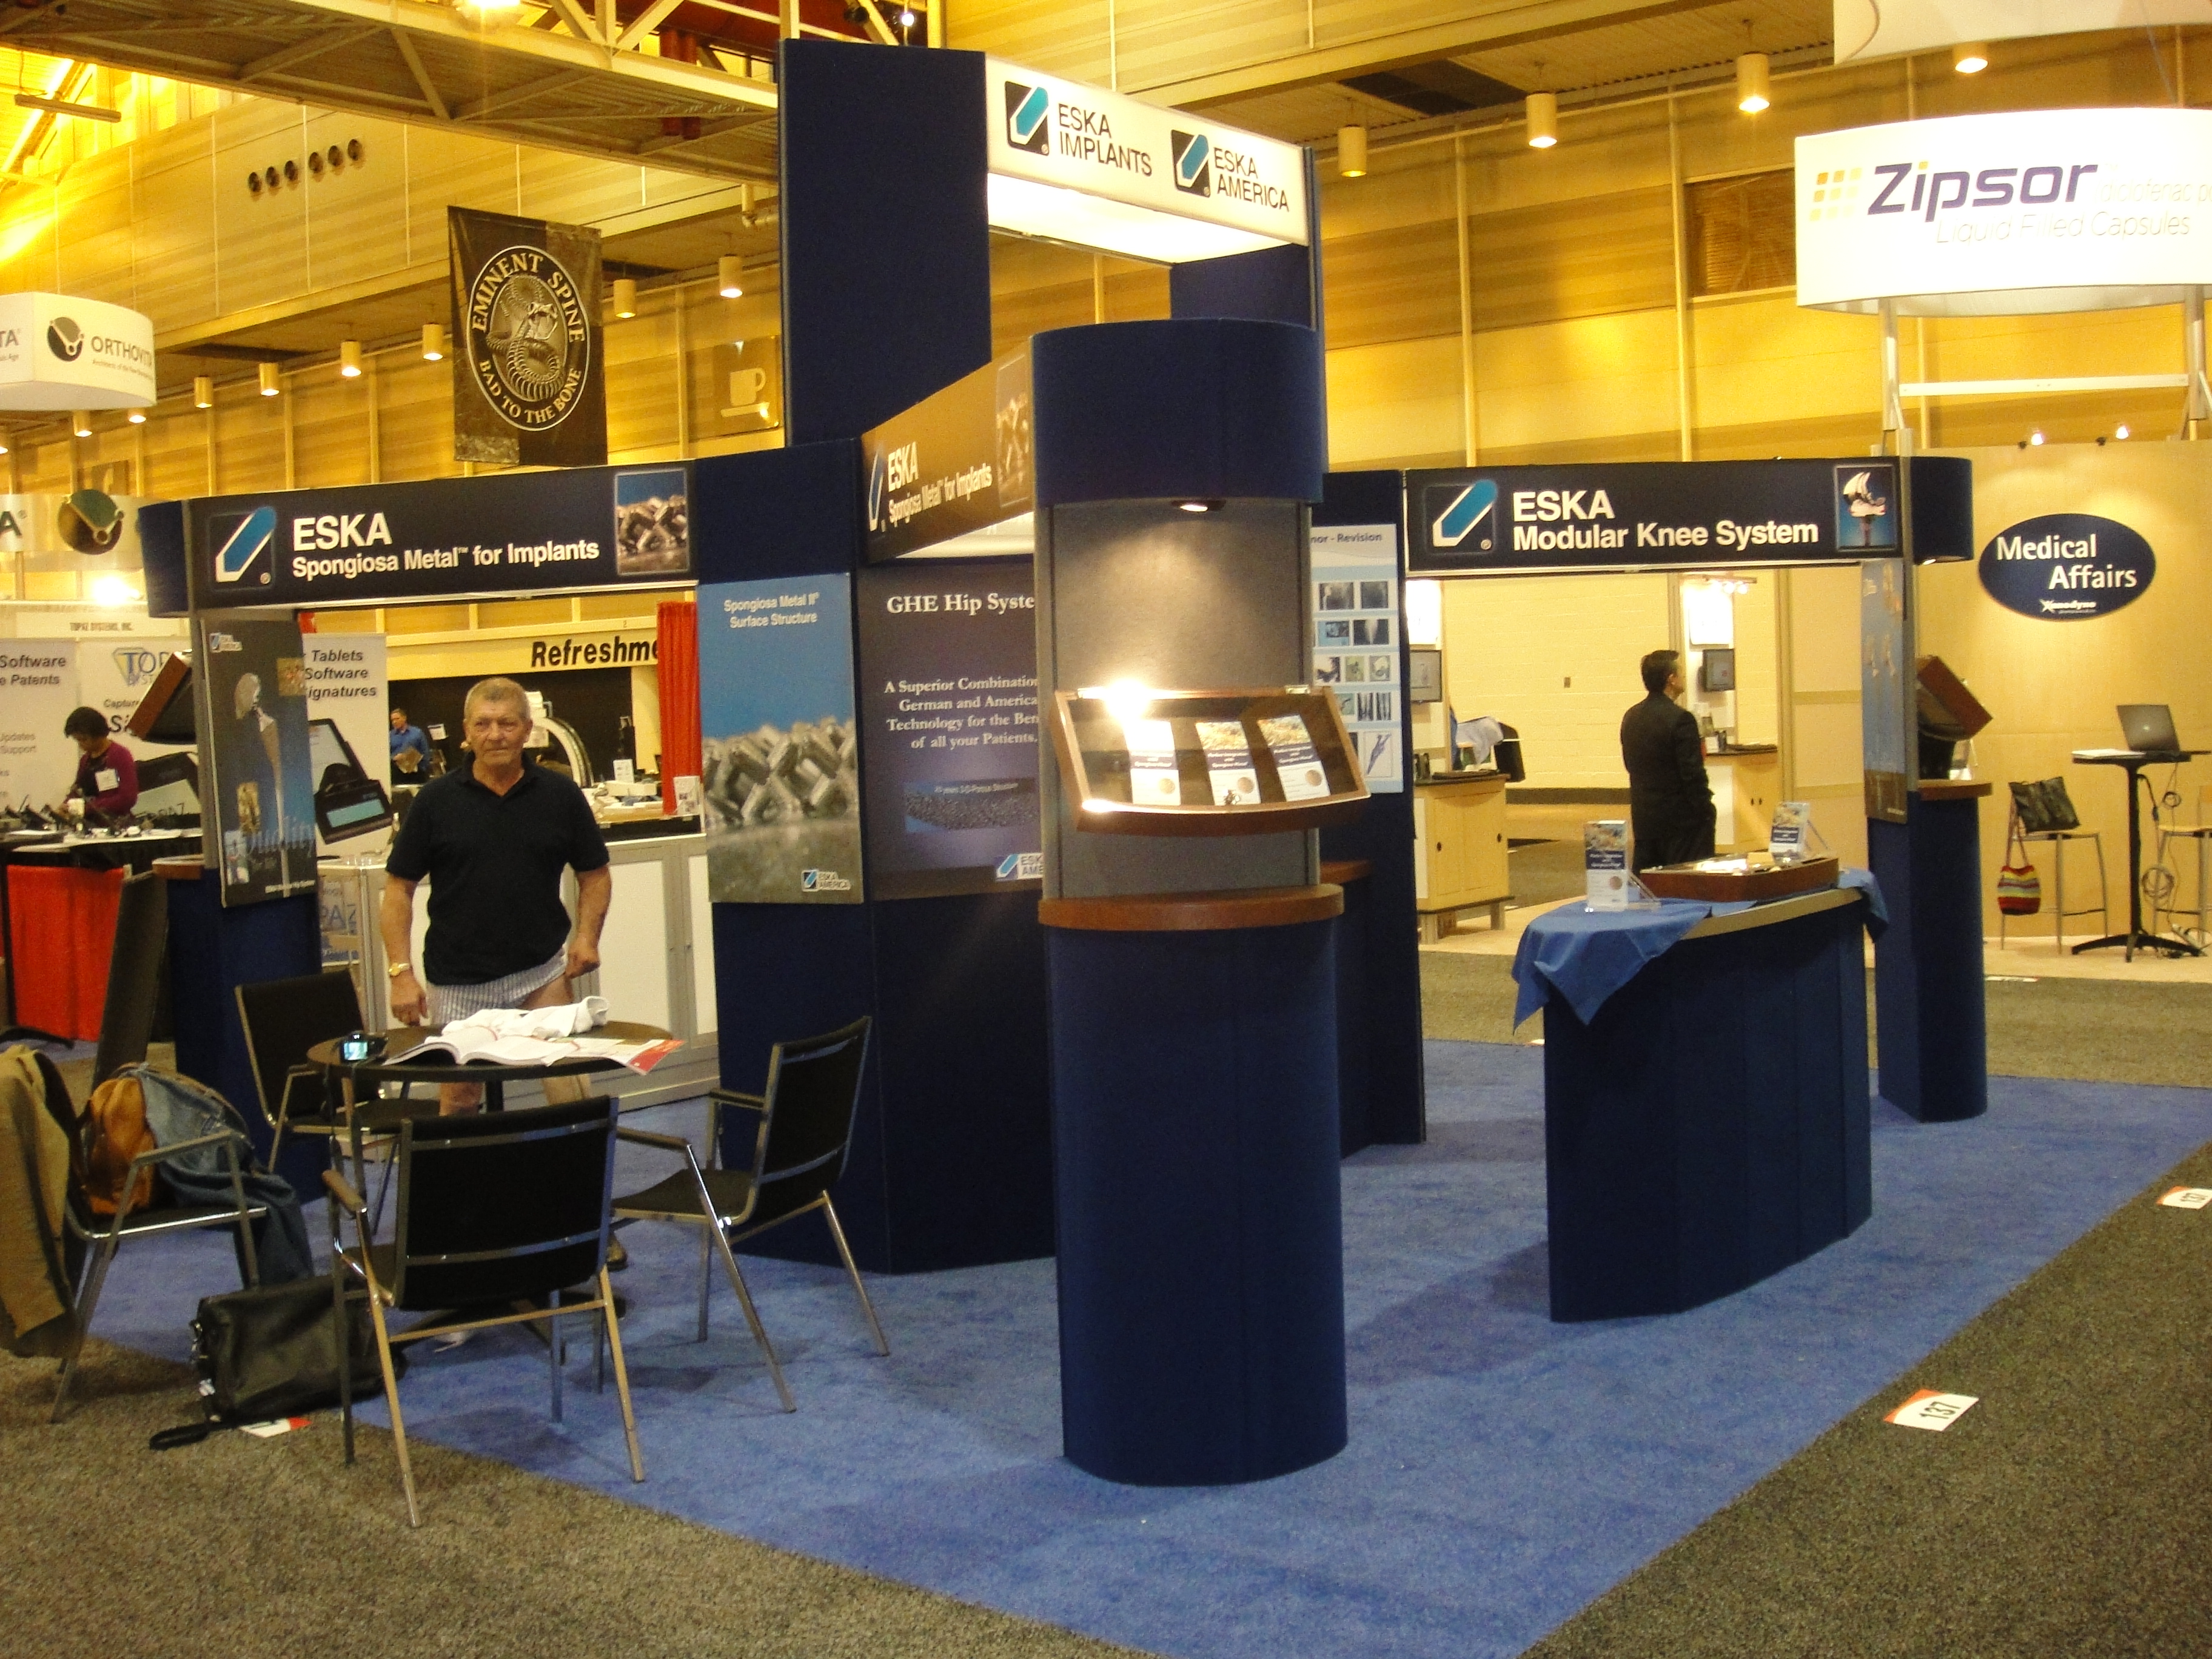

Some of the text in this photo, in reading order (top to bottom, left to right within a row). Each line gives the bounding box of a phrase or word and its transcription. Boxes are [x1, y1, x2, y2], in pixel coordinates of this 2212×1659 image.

[1058, 103, 1111, 138] ESKA
[1060, 132, 1152, 177] IMPLANTS
[1214, 147, 1258, 179] ESKA
[1217, 175, 1289, 212] AMERICA
[1868, 161, 2098, 223] Zipsor
[1937, 210, 2190, 246] Liquid Filled Capsules
[472, 253, 585, 343] EMINENT SPINE
[480, 361, 581, 424] BAD TO THE BONE
[888, 441, 919, 492] ESKA
[945, 477, 956, 501] for
[956, 463, 993, 501] Implants
[1513, 490, 1615, 522] ESKA
[293, 512, 392, 552] ESKA
[1337, 533, 1382, 543] Revision
[1513, 520, 1818, 552] Modular Knee System
[292, 548, 398, 581] Spongiosa
[473, 545, 502, 565] for
[508, 540, 599, 565] Implants
[1997, 534, 2097, 561] Medical
[2048, 564, 2137, 590] Affairs
[724, 597, 777, 614] Spongiosa
[779, 594, 807, 607] Metal
[886, 595, 939, 614] GHE
[944, 594, 982, 615] Hip
[730, 612, 818, 628] Surface Structure
[312, 649, 363, 662] Tablets
[11, 674, 60, 686] Patents
[305, 667, 368, 680] Software
[884, 681, 896, 694] A
[899, 679, 954, 695] Superior
[306, 686, 377, 700] ignatures
[899, 699, 953, 711] German
[956, 696, 980, 708] and
[886, 717, 964, 732] Technology
[967, 714, 985, 726] for
[990, 714, 1010, 725] the
[911, 736, 927, 749] of
[930, 735, 946, 748] all
[949, 736, 979, 750] your
[1919, 1401, 1961, 1419] 137
